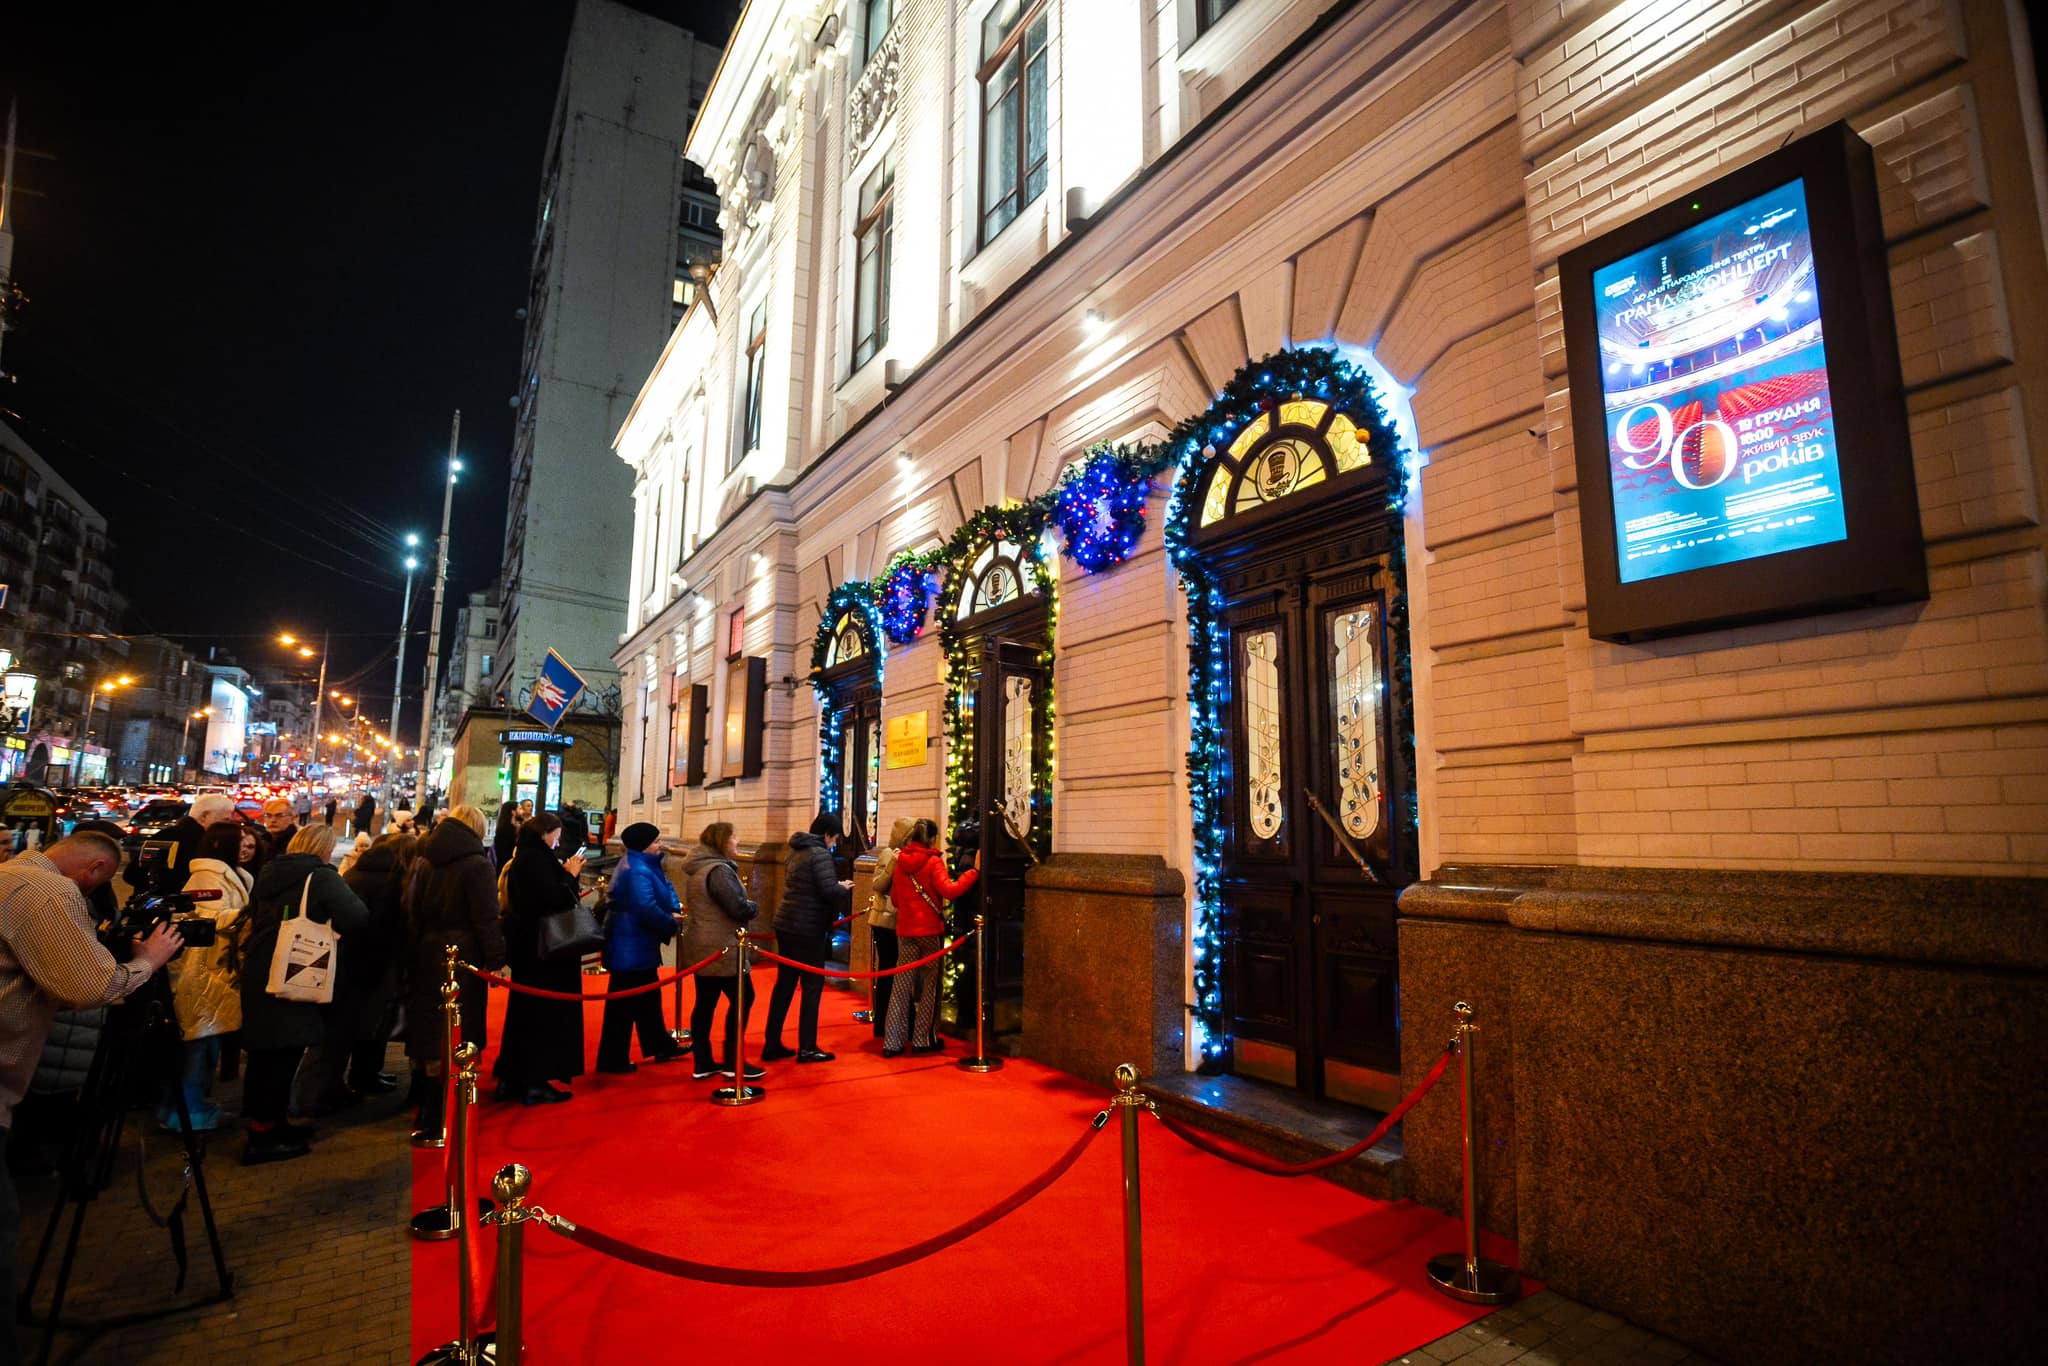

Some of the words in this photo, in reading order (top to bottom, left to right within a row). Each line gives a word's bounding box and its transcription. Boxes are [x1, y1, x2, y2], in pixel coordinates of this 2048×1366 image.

[1731, 241, 1767, 262] ТЕАТРУ
[1755, 397, 1821, 428] ГРУДНЯ
[1616, 402, 1738, 490] 90
[1742, 436, 1789, 458] ЖИВИЙ
[1791, 428, 1825, 444] ЗВУК
[1743, 442, 1825, 484] років
